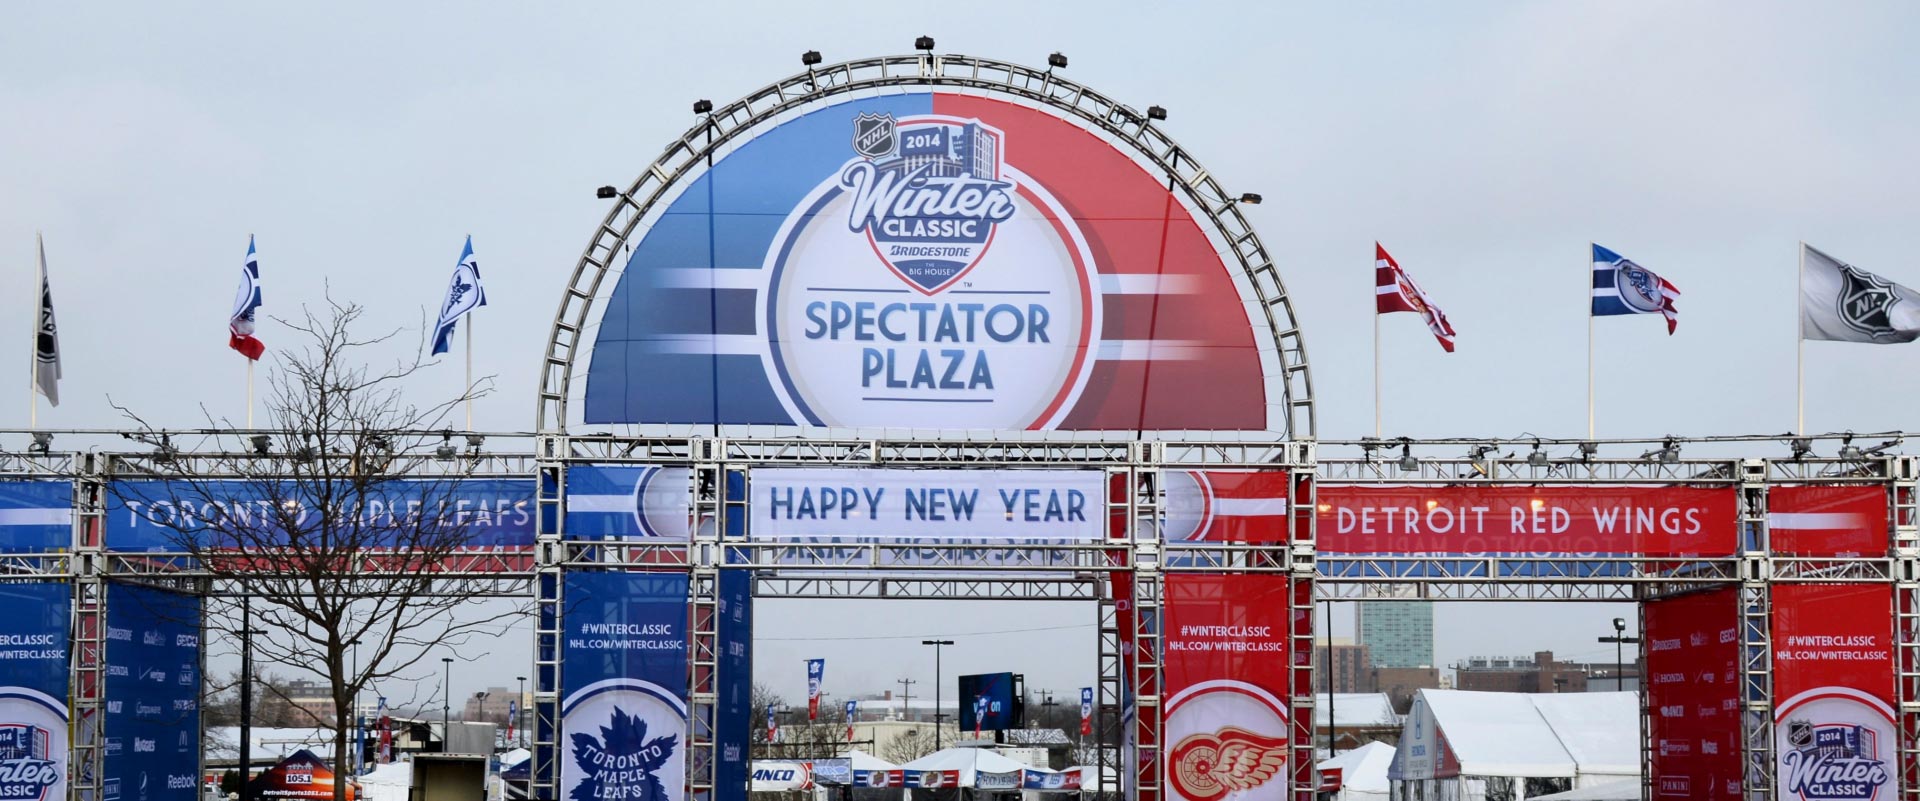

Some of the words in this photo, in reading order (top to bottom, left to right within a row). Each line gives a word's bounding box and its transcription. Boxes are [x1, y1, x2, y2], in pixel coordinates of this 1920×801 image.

[862, 125, 889, 149] NHL
[906, 134, 941, 149] 2014
[842, 161, 1016, 233] Winter
[883, 219, 977, 238] CLASSIC
[890, 245, 971, 257] BRIDGESTONE
[909, 268, 922, 276] BIG
[804, 301, 1051, 343] SPECTATOR
[861, 347, 995, 390] PLAZA
[770, 486, 885, 520] HAPPY
[905, 488, 979, 521] NEW
[999, 488, 1086, 522] YEAR
[126, 500, 307, 528] TORONTO
[438, 499, 530, 528] LEAFS
[1337, 506, 1490, 534] DETROIT
[1510, 506, 1571, 534] RED
[1592, 505, 1702, 535] WINGS
[581, 623, 672, 635] #WINTERCLASSIC
[1181, 625, 1271, 637] #WINTERCLASSIC
[569, 639, 683, 650] NHL.COM/WINTERCLASSIC
[1169, 641, 1283, 652] NHL.COM/WINTERCLASSIC
[1787, 635, 1876, 647] #WINTERCLASSIC
[1777, 651, 1888, 661] NHL.COM/WINTERCLASSIC
[1793, 727, 1809, 741] NHL
[1819, 732, 1841, 742] 2014
[582, 744, 662, 769] TORONTO
[287, 774, 312, 783] 105.1
[594, 768, 646, 784] MAPLE
[1783, 750, 1888, 793] Winter
[168, 774, 196, 789] Reebok
[1662, 781, 1689, 791] PANINI
[593, 784, 642, 798] LEAFS
[1809, 784, 1866, 796] CLASSIC
